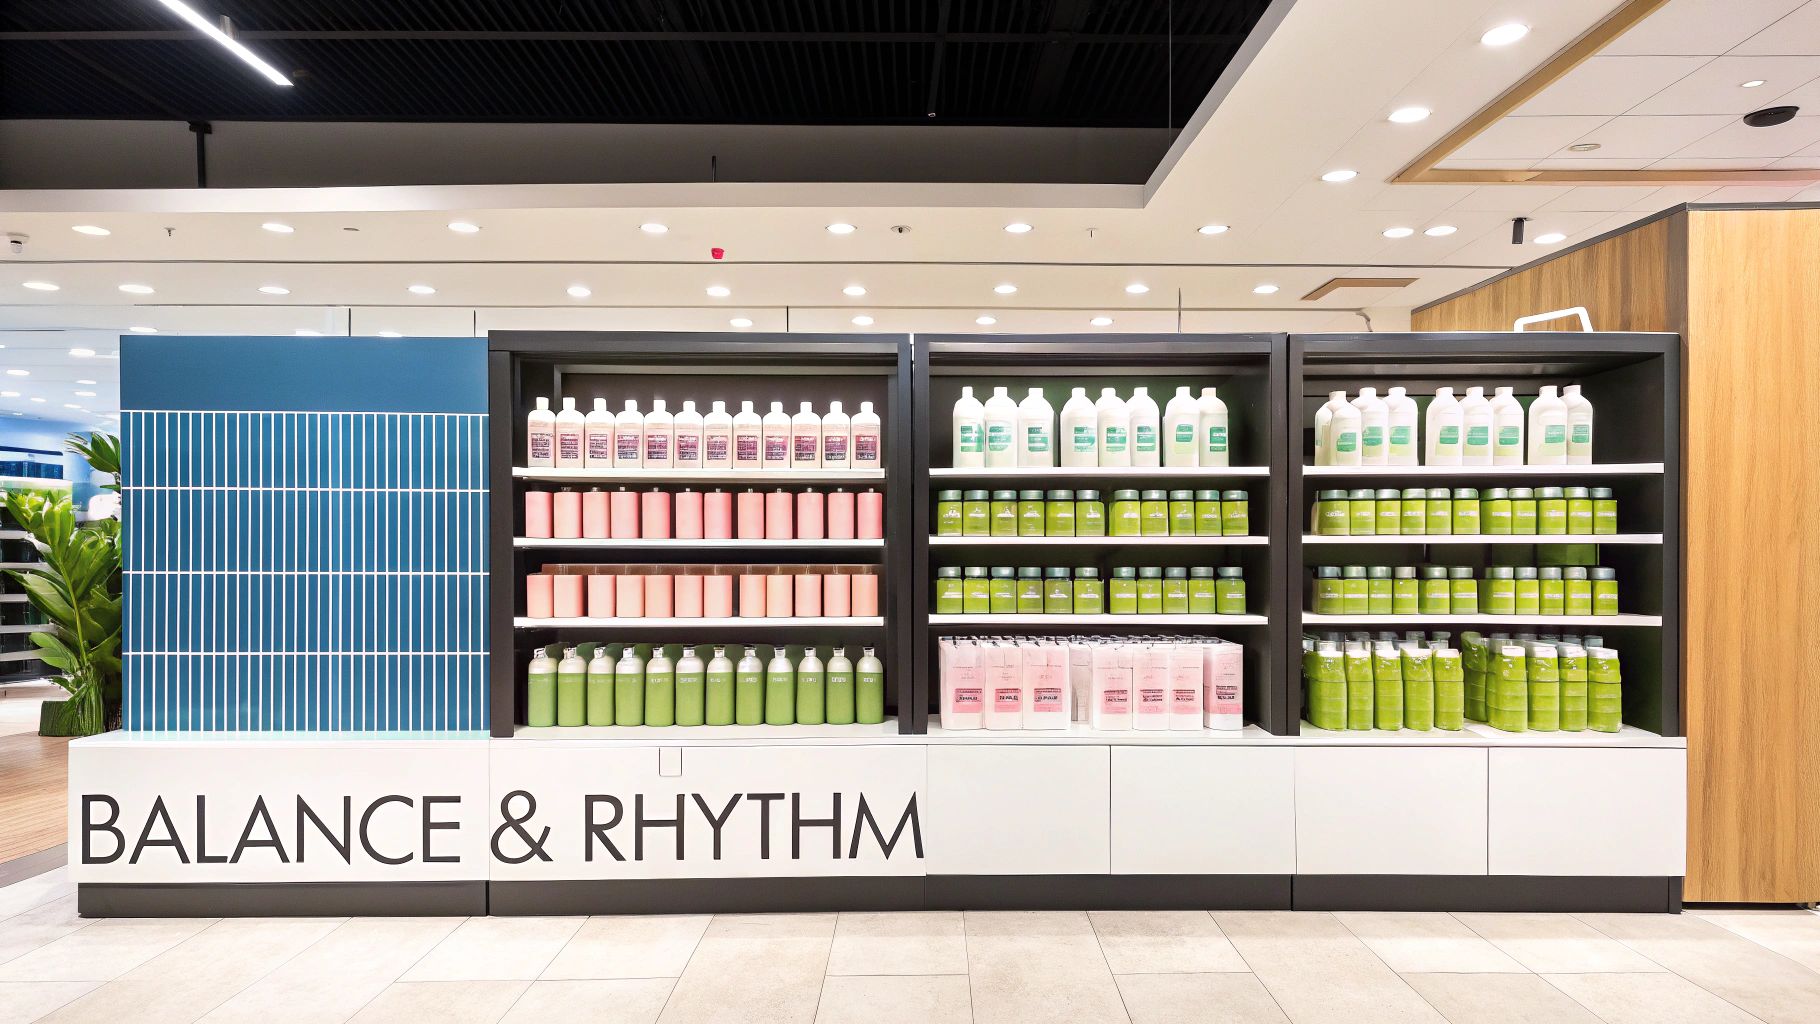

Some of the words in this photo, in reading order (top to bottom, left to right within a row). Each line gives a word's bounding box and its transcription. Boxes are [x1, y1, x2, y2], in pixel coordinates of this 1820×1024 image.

[82, 794, 461, 866] BALANCE
[491, 789, 553, 865] &
[585, 792, 925, 863] RHYTHM
